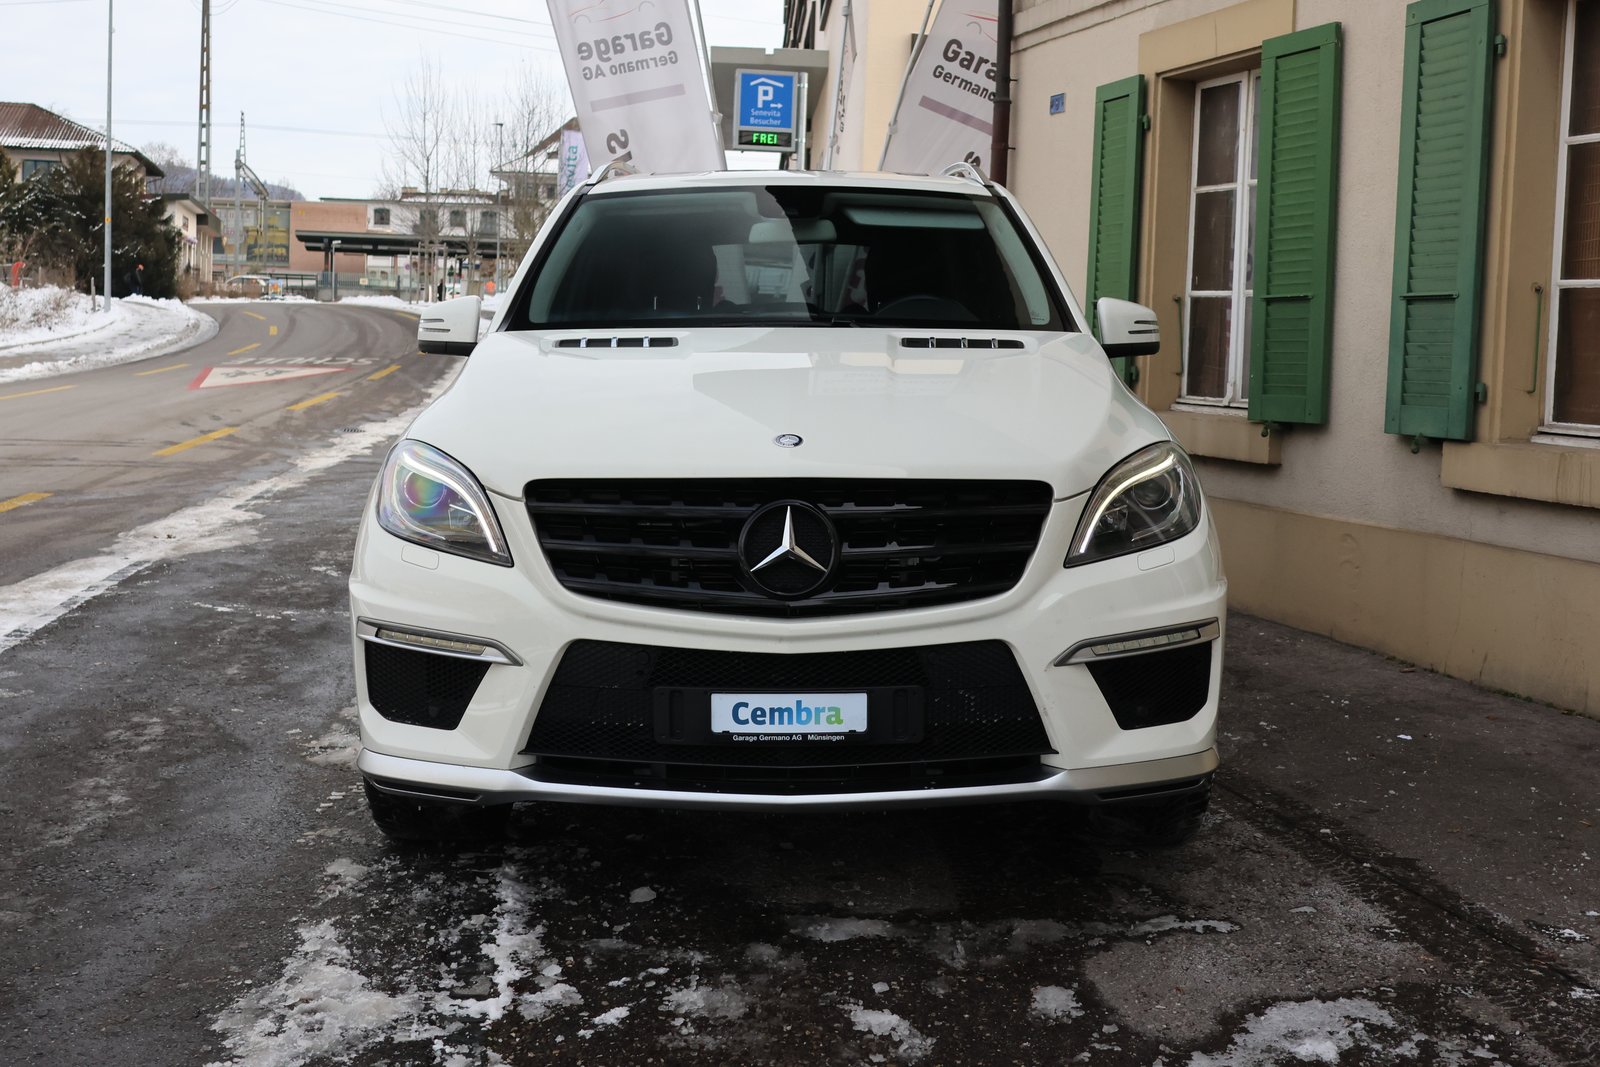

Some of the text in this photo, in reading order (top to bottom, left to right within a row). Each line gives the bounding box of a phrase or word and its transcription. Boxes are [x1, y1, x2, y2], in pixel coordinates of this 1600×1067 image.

[757, 86, 774, 108] P
[750, 108, 781, 117] Senevita
[749, 117, 781, 126] Besucher
[752, 132, 778, 145] FREI
[731, 699, 844, 726] Cembra
[732, 734, 758, 742] Garage
[807, 734, 845, 742] Münsingen
